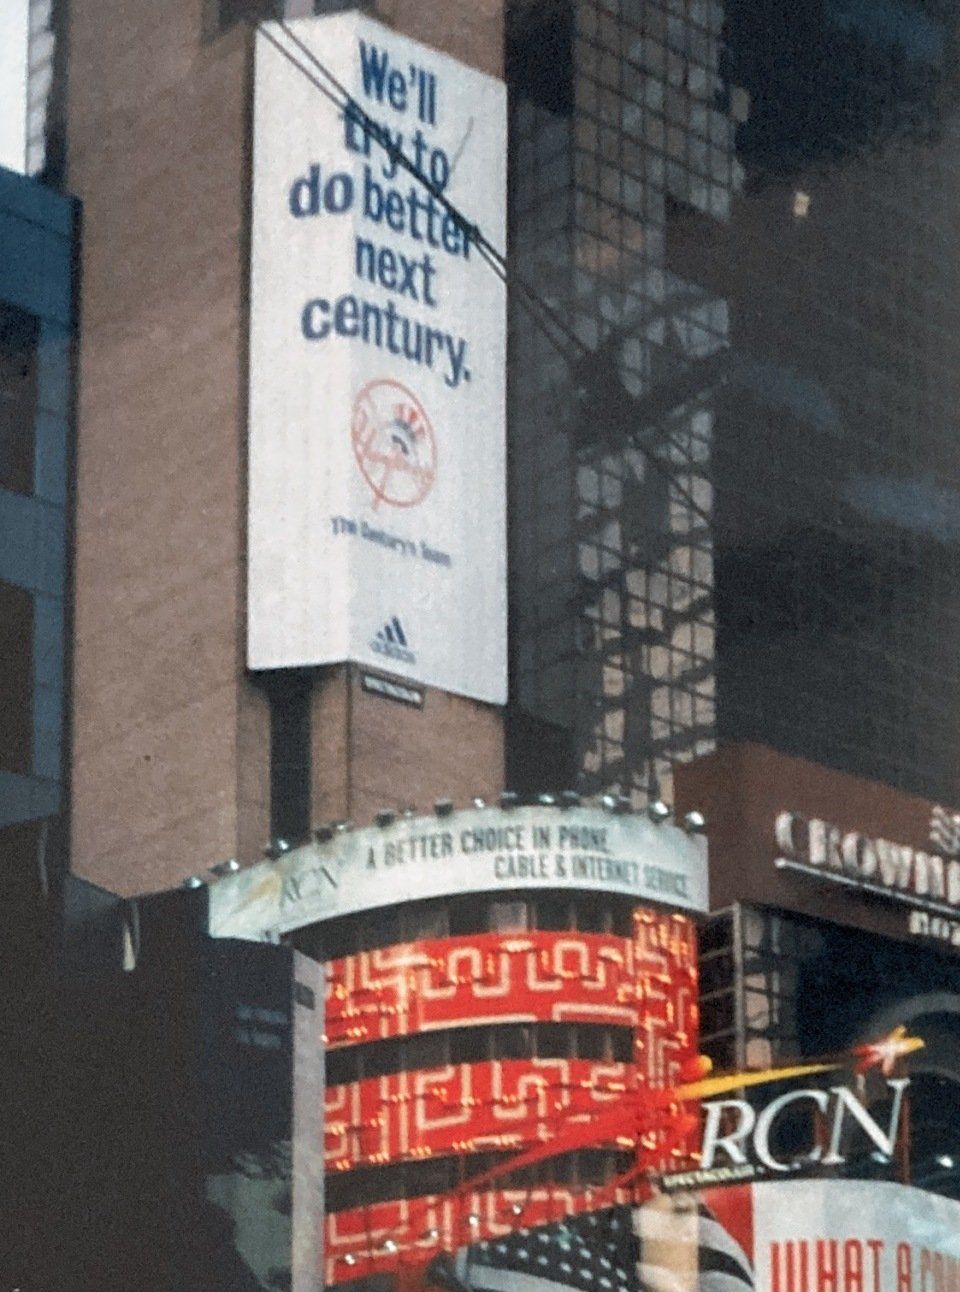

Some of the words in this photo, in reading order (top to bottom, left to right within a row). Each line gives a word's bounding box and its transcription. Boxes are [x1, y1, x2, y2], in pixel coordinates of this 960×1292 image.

[359, 38, 437, 126] We'll
[340, 102, 404, 180] try
[411, 128, 452, 195] to
[288, 162, 352, 219] do
[362, 166, 472, 259] better
[355, 235, 436, 307] next
[300, 294, 472, 388] century.
[366, 845, 377, 870] A
[384, 832, 454, 867] BETTER
[460, 823, 524, 853] CHOICE
[532, 824, 551, 850] IN
[557, 824, 609, 853] PHONE
[494, 853, 550, 880] CABLE
[571, 855, 640, 887] INTERNET
[700, 1077, 911, 1172] RCN
